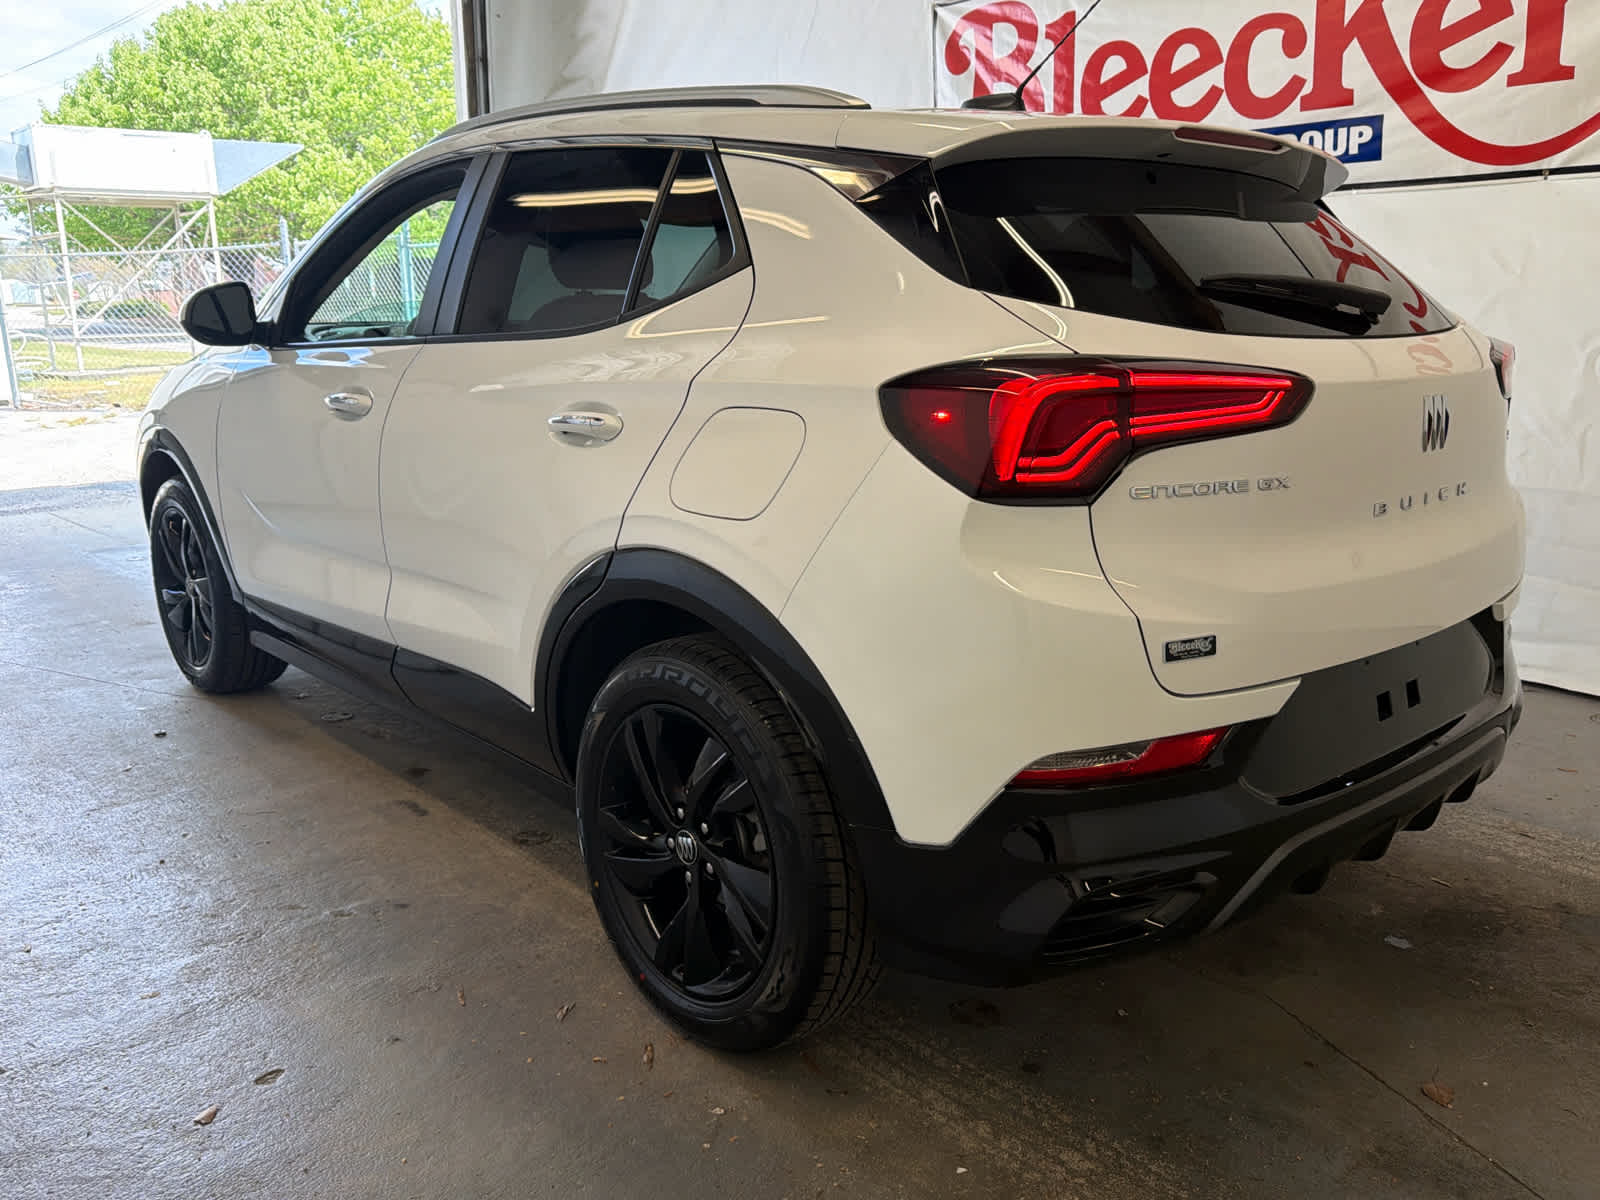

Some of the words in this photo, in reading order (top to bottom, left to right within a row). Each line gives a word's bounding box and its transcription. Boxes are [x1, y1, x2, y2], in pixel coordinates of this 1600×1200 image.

[1274, 125, 1373, 157] OUP
[1129, 479, 1249, 500] ENCORE
[1257, 475, 1290, 491] GX
[1372, 481, 1468, 519] BUICK
